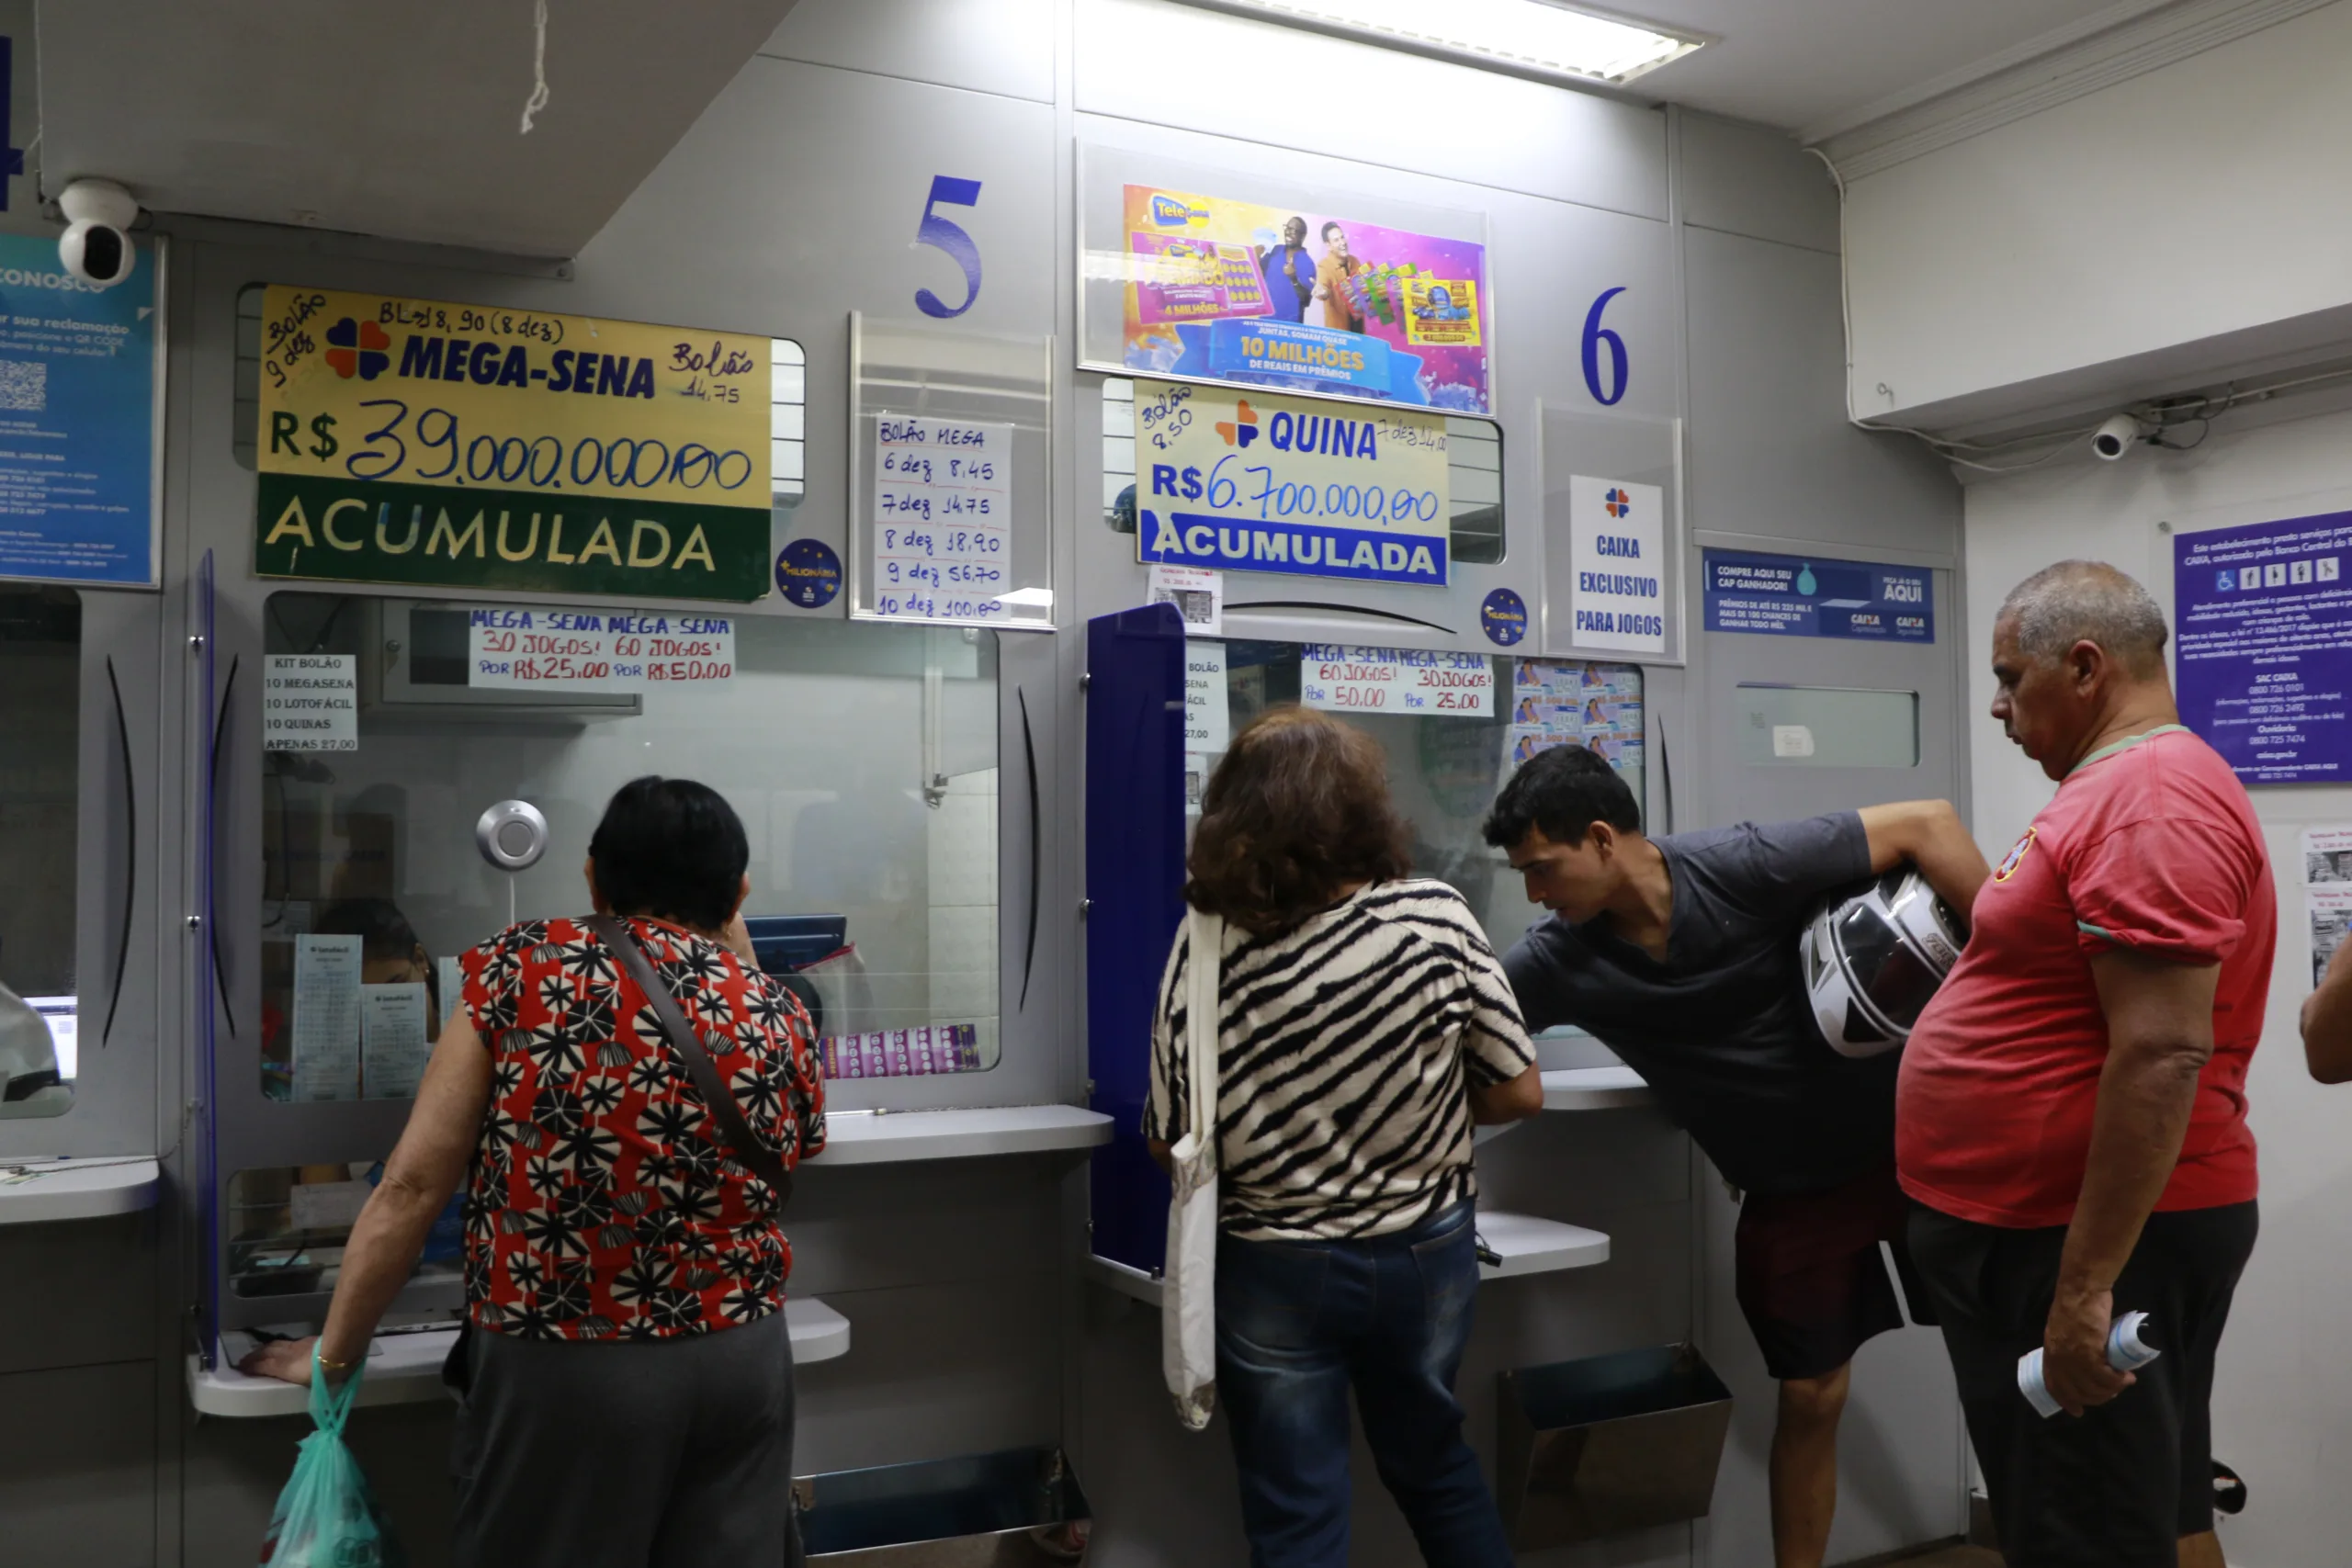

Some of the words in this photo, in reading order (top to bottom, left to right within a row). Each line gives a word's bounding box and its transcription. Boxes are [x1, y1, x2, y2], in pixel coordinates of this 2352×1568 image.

[1157, 202, 1185, 218] Tele
[915, 175, 982, 318] 5
[1165, 304, 1172, 316] 4
[1175, 301, 1220, 316] MILHÕES
[1258, 327, 1290, 338] JUNTAS,
[1291, 331, 1321, 342] SOMAM
[1323, 335, 1348, 345] QUASE
[1582, 286, 1629, 406] 6
[1241, 336, 1265, 357] 10
[1268, 340, 1364, 370] MILHÕES
[266, 359, 287, 388] 9
[399, 334, 656, 399] MEGA-SENA
[1250, 359, 1262, 368] DE
[1264, 361, 1292, 371] REAIS
[1293, 364, 1307, 374] EM
[1308, 365, 1351, 380] PRÊMIOS
[270, 410, 339, 461] R$
[880, 420, 925, 443] BOLÃO
[937, 428, 985, 447] MEGA
[1270, 411, 1377, 460] QUINA
[884, 453, 895, 470] 6
[901, 456, 933, 483] dez
[1152, 463, 1204, 502] R$
[1207, 454, 1439, 526] 6.700.000,00
[882, 494, 897, 515] 7
[899, 493, 932, 520] dez
[265, 494, 716, 572] ACUMULADA
[885, 530, 897, 548] 8
[904, 530, 933, 556] dez
[2193, 544, 2209, 553] Este
[2211, 537, 2272, 551] estabelecimento
[2273, 533, 2299, 544] presta
[2300, 529, 2333, 540] serviços
[1150, 514, 1438, 576] ACUMULADA
[1597, 535, 1640, 558] CAIXA
[2275, 546, 2301, 555] Banco
[2301, 540, 2333, 552] Central
[2334, 539, 2346, 548] do
[888, 562, 899, 582] 9
[910, 564, 940, 587] dez
[1717, 566, 1752, 577] COMPRE
[1753, 569, 1775, 578] AQUI
[1776, 570, 1792, 579] SEU
[1717, 578, 1736, 587] CAP
[1580, 571, 1657, 598] EXCLUSIVO
[1883, 584, 1922, 603] AQUI
[877, 599, 899, 616] 10
[906, 593, 933, 618] dez
[1718, 598, 1748, 608] PRÊMIOS
[1749, 601, 1758, 609] DE
[1758, 600, 1770, 610] ATÉ
[1795, 604, 1806, 613] MIL
[1719, 609, 1736, 617] MAIS
[1737, 610, 1747, 618] DE
[1748, 611, 1760, 619] 100
[1761, 612, 1792, 621] CHANCES
[1577, 610, 1614, 632] PARA
[1617, 613, 1662, 636] JOGOS
[1719, 618, 1749, 627] GANHAR
[1750, 620, 1770, 628] TODO
[1850, 614, 1880, 625] CAIXA
[1896, 616, 1925, 627] CAIXA
[482, 630, 516, 652] 30
[522, 635, 601, 656] JOGOS!
[615, 636, 641, 656] 60
[275, 658, 296, 669] KIT
[300, 657, 342, 669] BOLÃO
[480, 660, 510, 674] POR
[614, 663, 642, 677] POR
[1189, 661, 1219, 673] BOLÃO
[1319, 663, 1341, 681] 60
[266, 679, 281, 688] 10
[284, 679, 354, 689] MEGASENA
[266, 699, 281, 708] 10
[285, 697, 353, 709] LOTOFÁCIL
[266, 719, 281, 728] 10
[285, 719, 331, 729] QUINAS
[2257, 723, 2297, 734] Ouvidoria
[266, 739, 318, 750] APENAS
[321, 739, 356, 750] 27,00
